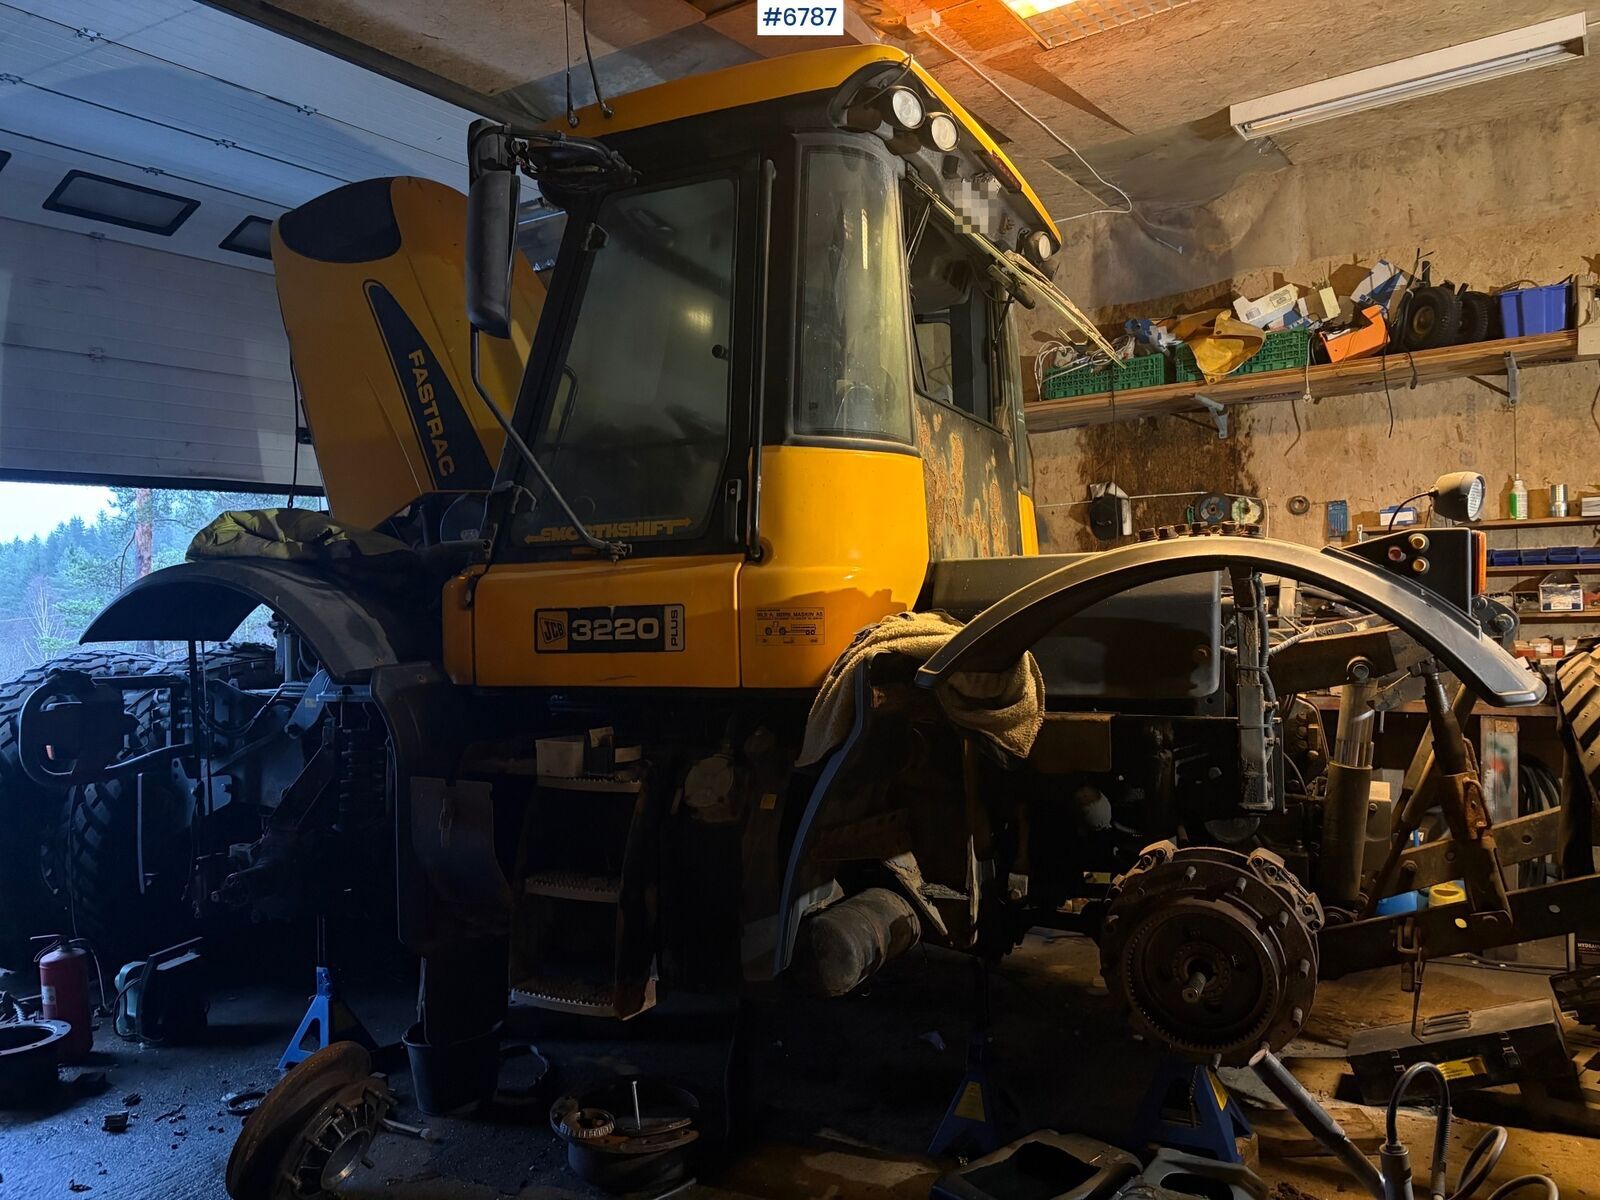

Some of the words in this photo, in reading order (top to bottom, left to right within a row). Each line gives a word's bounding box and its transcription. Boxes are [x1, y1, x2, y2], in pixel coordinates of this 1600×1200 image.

[408, 348, 456, 477] FASTRAC
[543, 620, 566, 641] JCB
[571, 617, 660, 640] 3220
[670, 609, 679, 647] PLUS
